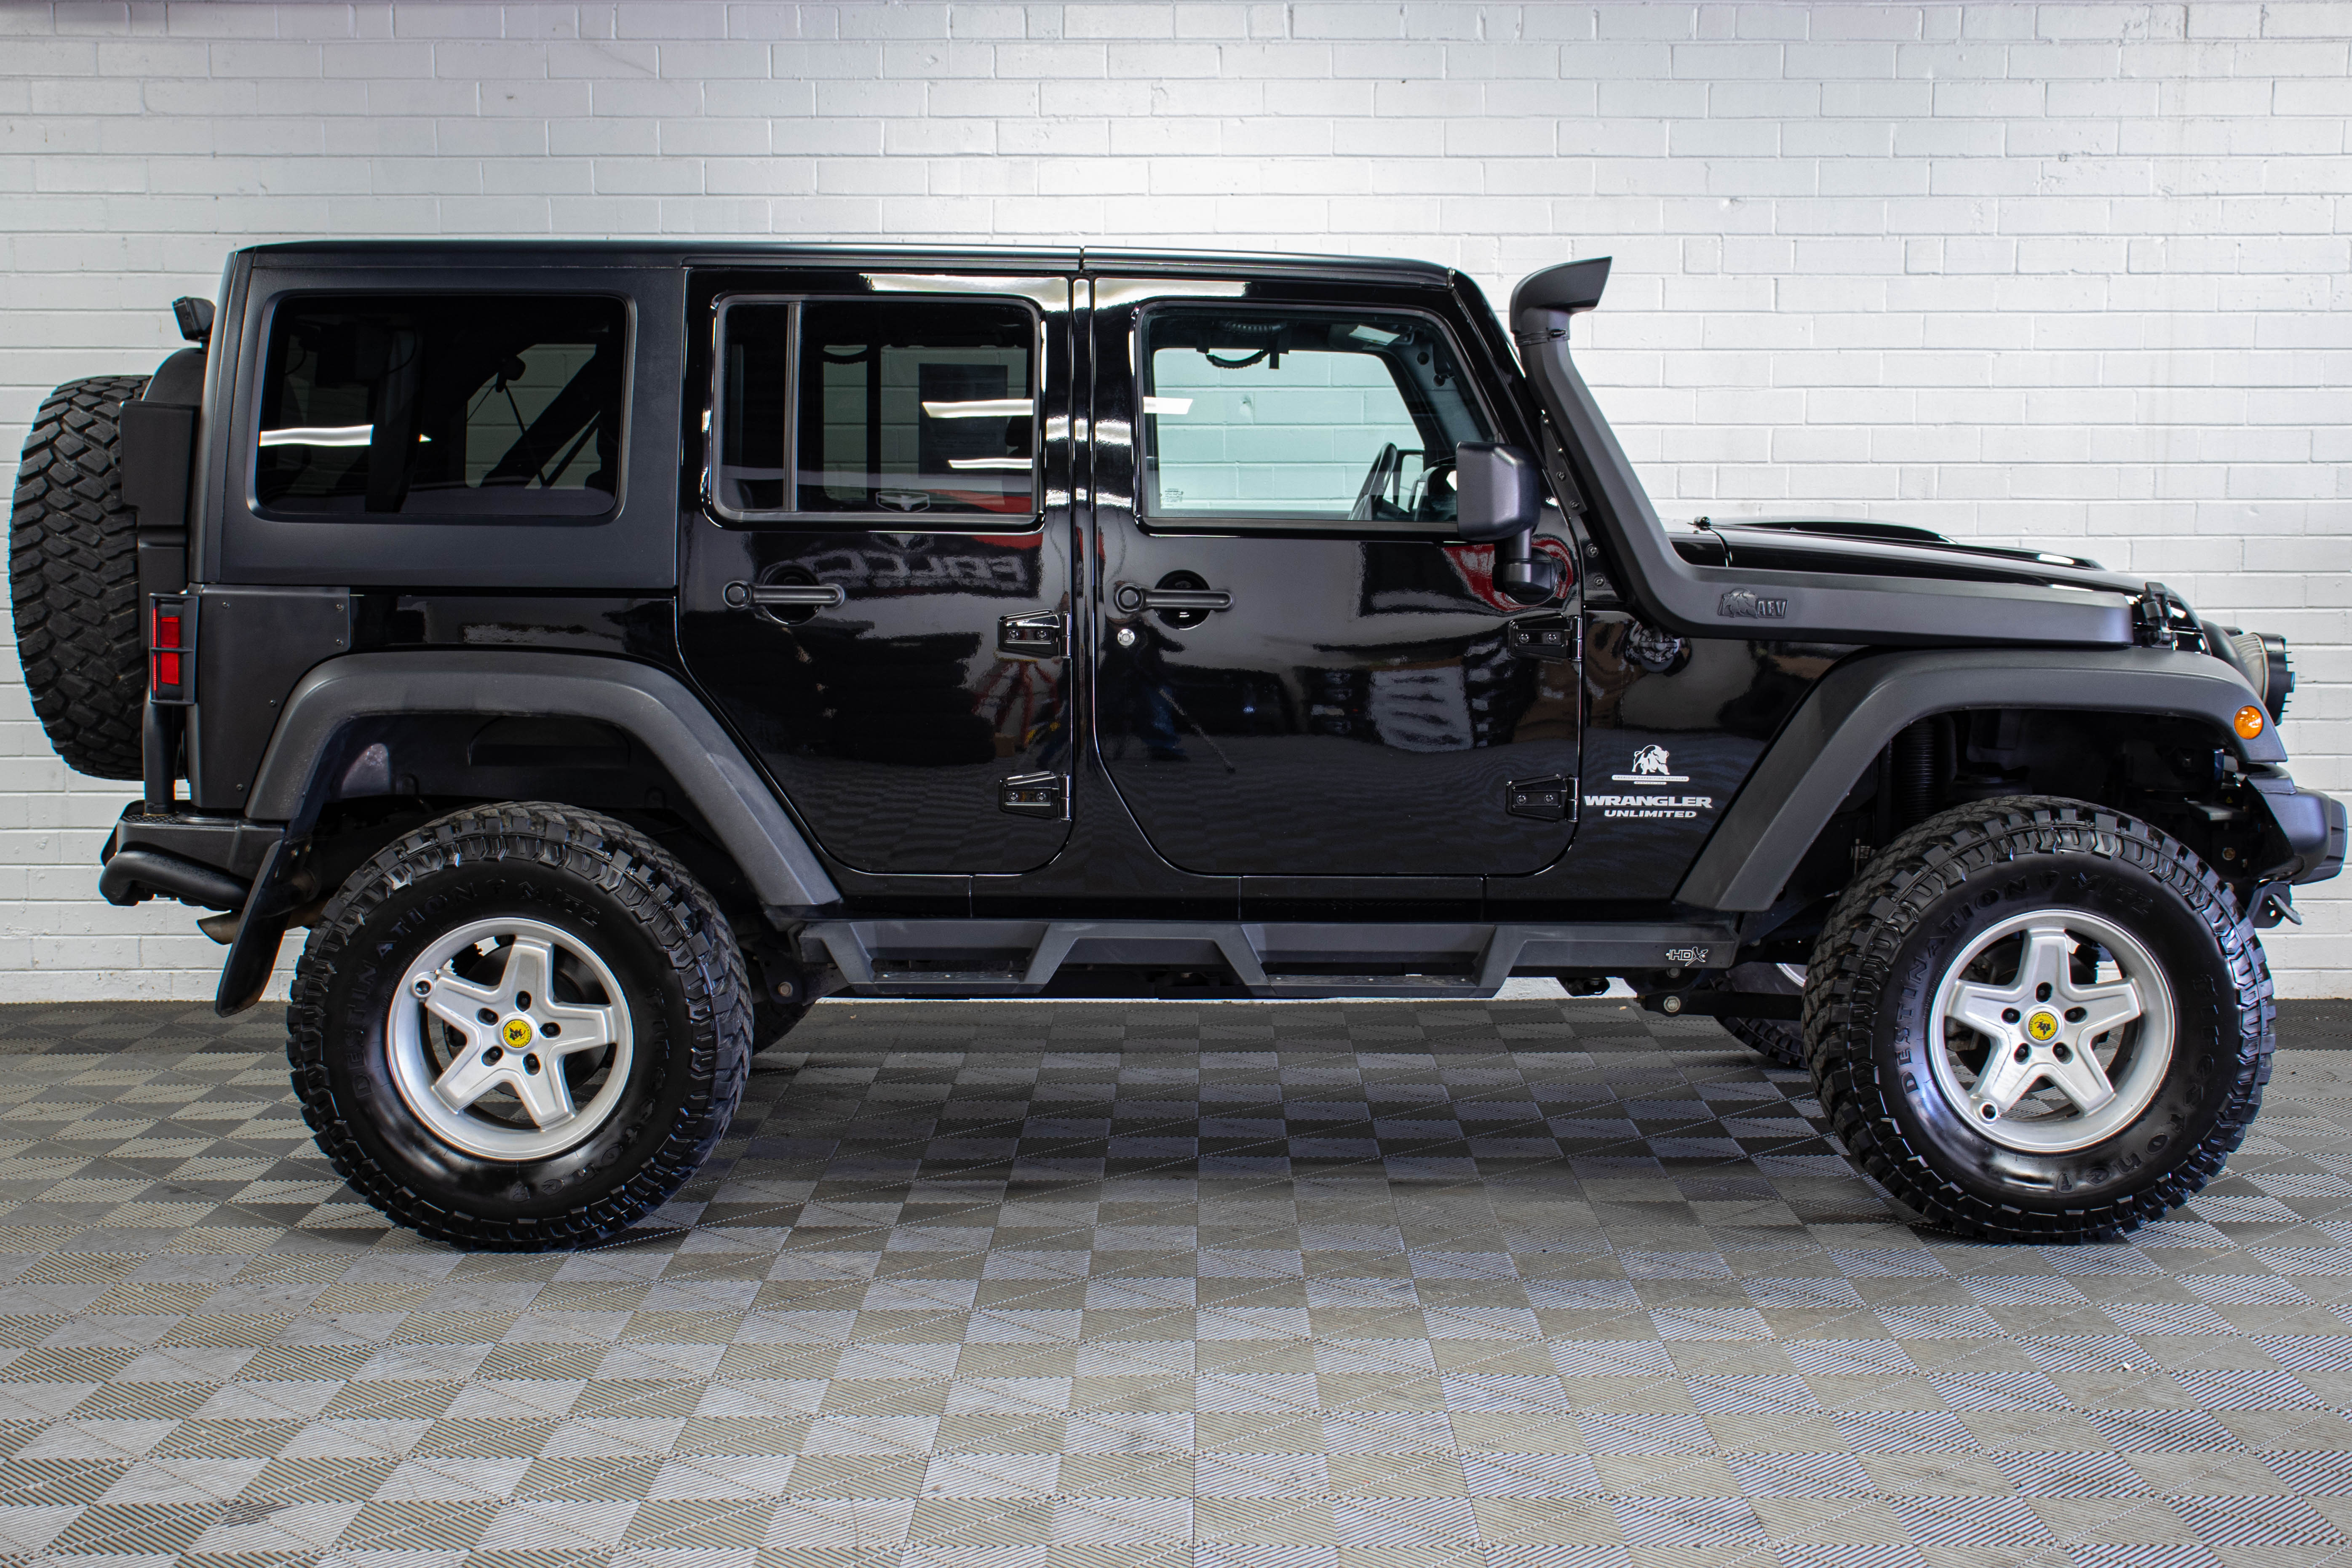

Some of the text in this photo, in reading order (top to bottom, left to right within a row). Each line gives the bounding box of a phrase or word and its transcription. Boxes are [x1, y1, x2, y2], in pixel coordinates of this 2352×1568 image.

[1757, 600, 1786, 617] AEV
[1584, 795, 1713, 808] WRANGLER
[1604, 810, 1697, 818] UNLIMITED
[1671, 946, 1708, 966] HDX
[345, 882, 477, 1098] DESTINATION
[1894, 874, 2029, 1095] DESTINATION
